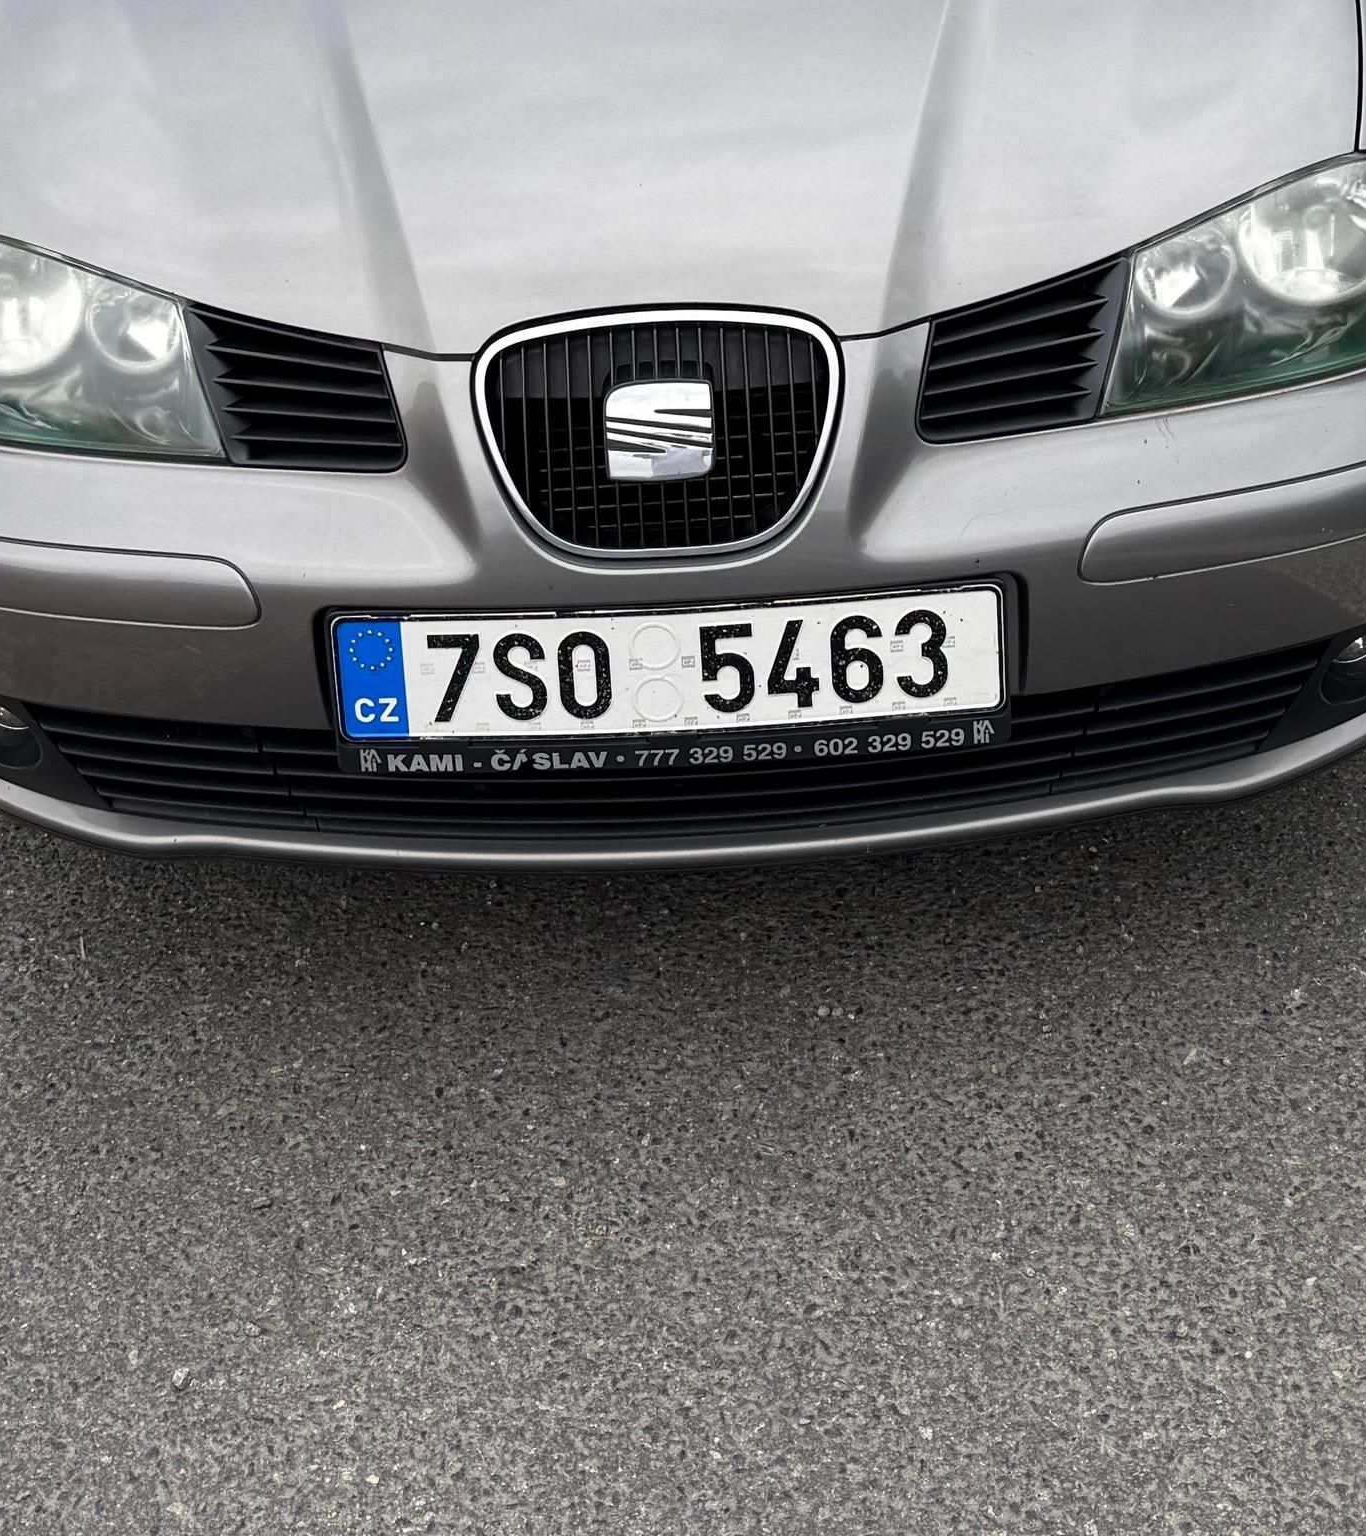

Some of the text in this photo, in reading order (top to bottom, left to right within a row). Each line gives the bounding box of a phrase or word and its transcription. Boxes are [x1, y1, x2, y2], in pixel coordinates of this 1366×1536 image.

[699, 609, 948, 713] 5463
[354, 697, 400, 723] CZ
[387, 753, 464, 772] KAMI
[635, 748, 680, 767] 777
[688, 746, 734, 765] 329
[742, 742, 787, 762] 529
[813, 737, 859, 757] 602
[867, 733, 912, 754] 329
[920, 728, 966, 749] 529
